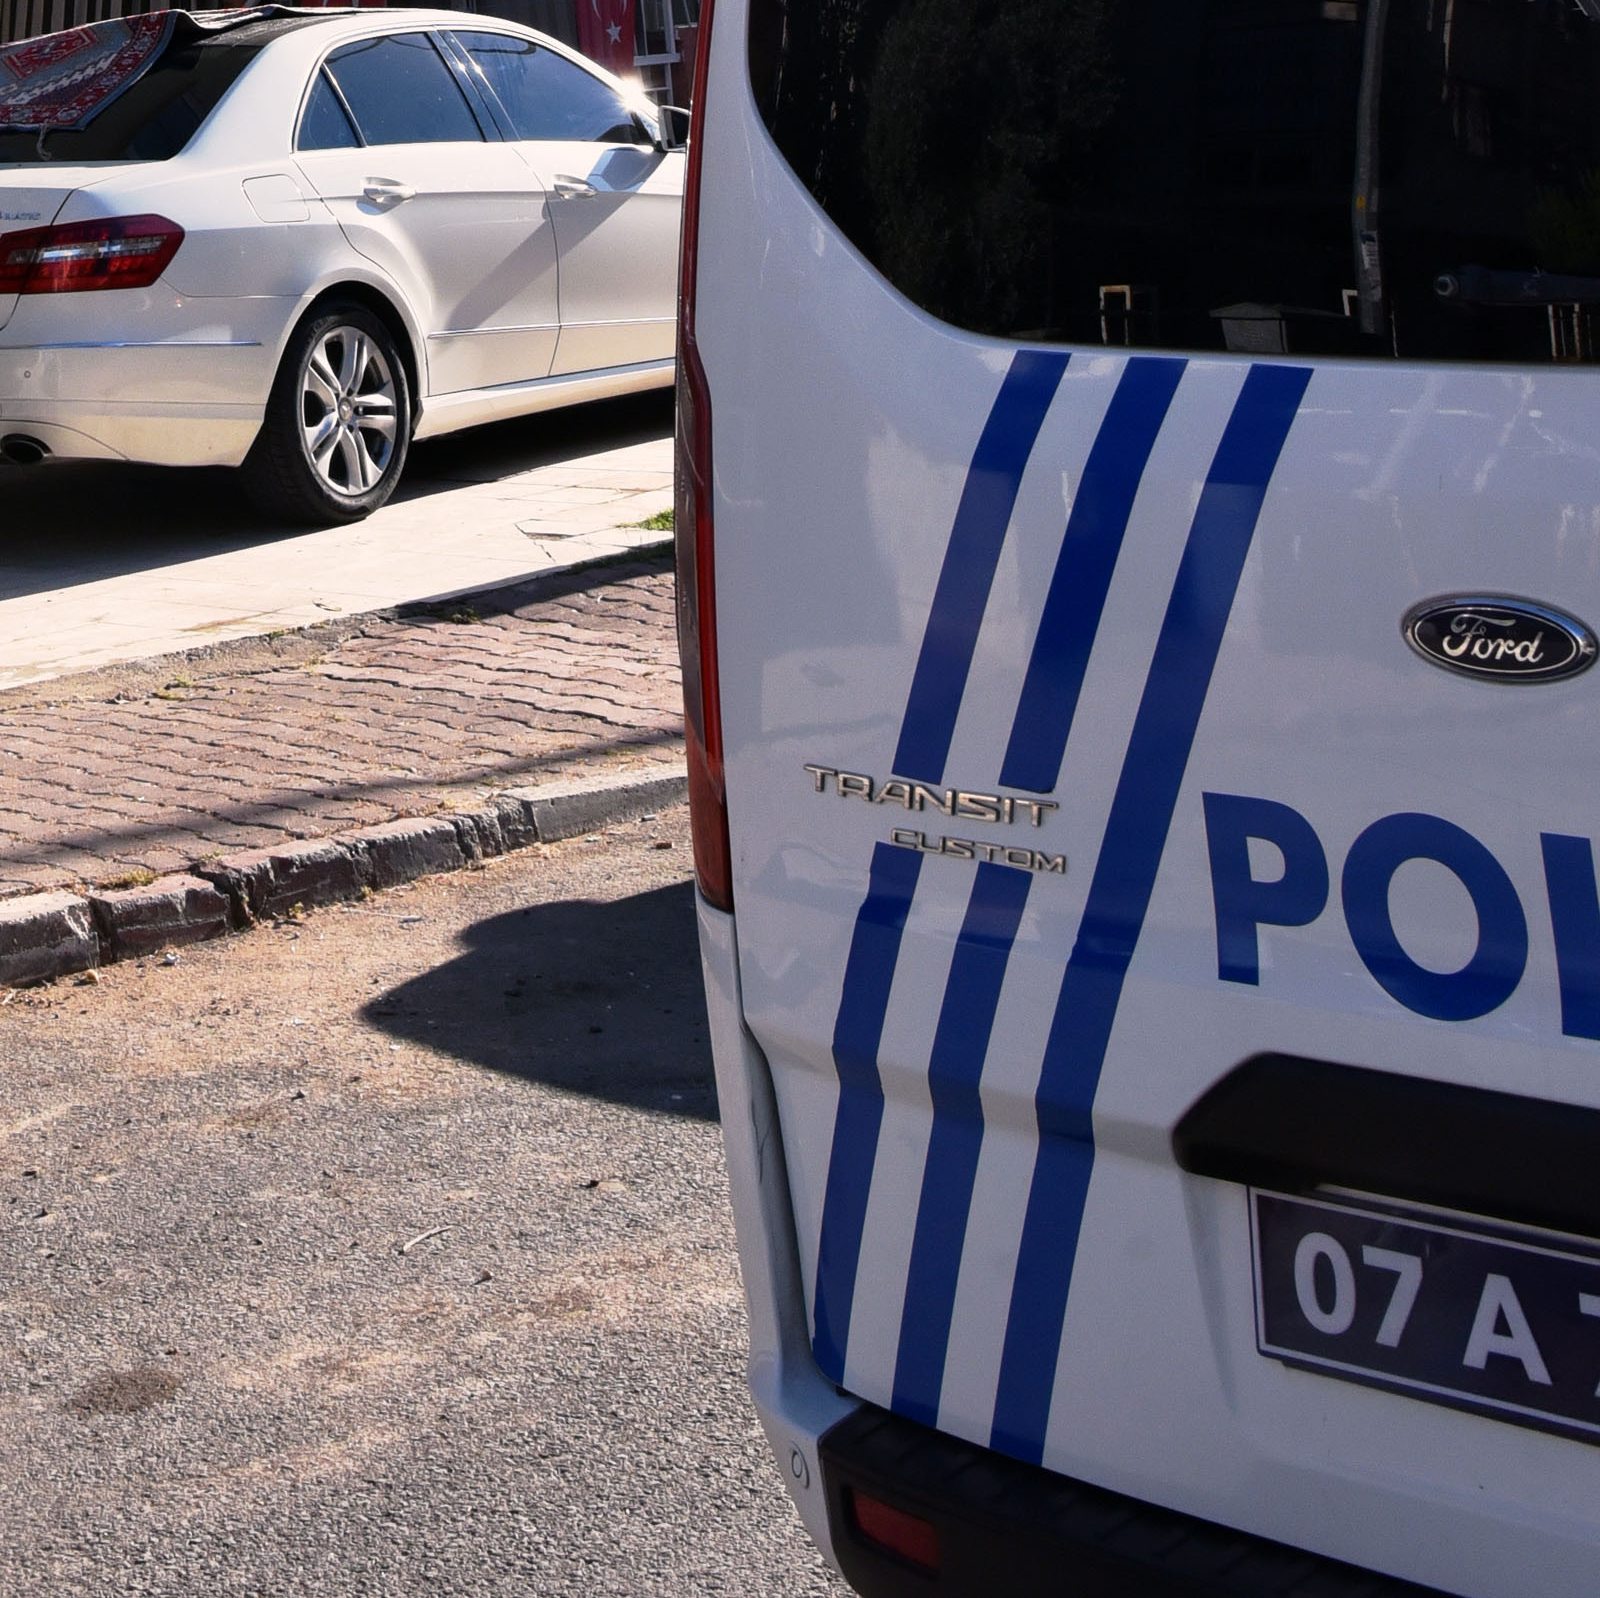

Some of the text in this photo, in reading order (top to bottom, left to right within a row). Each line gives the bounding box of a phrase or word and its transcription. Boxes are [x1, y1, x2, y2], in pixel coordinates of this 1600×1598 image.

[1442, 613, 1544, 663] Ford
[803, 763, 1060, 829] TRANSIT
[890, 827, 1066, 875] CUSTOM
[1294, 1231, 1424, 1349] 07
[1462, 1271, 1553, 1386] A
